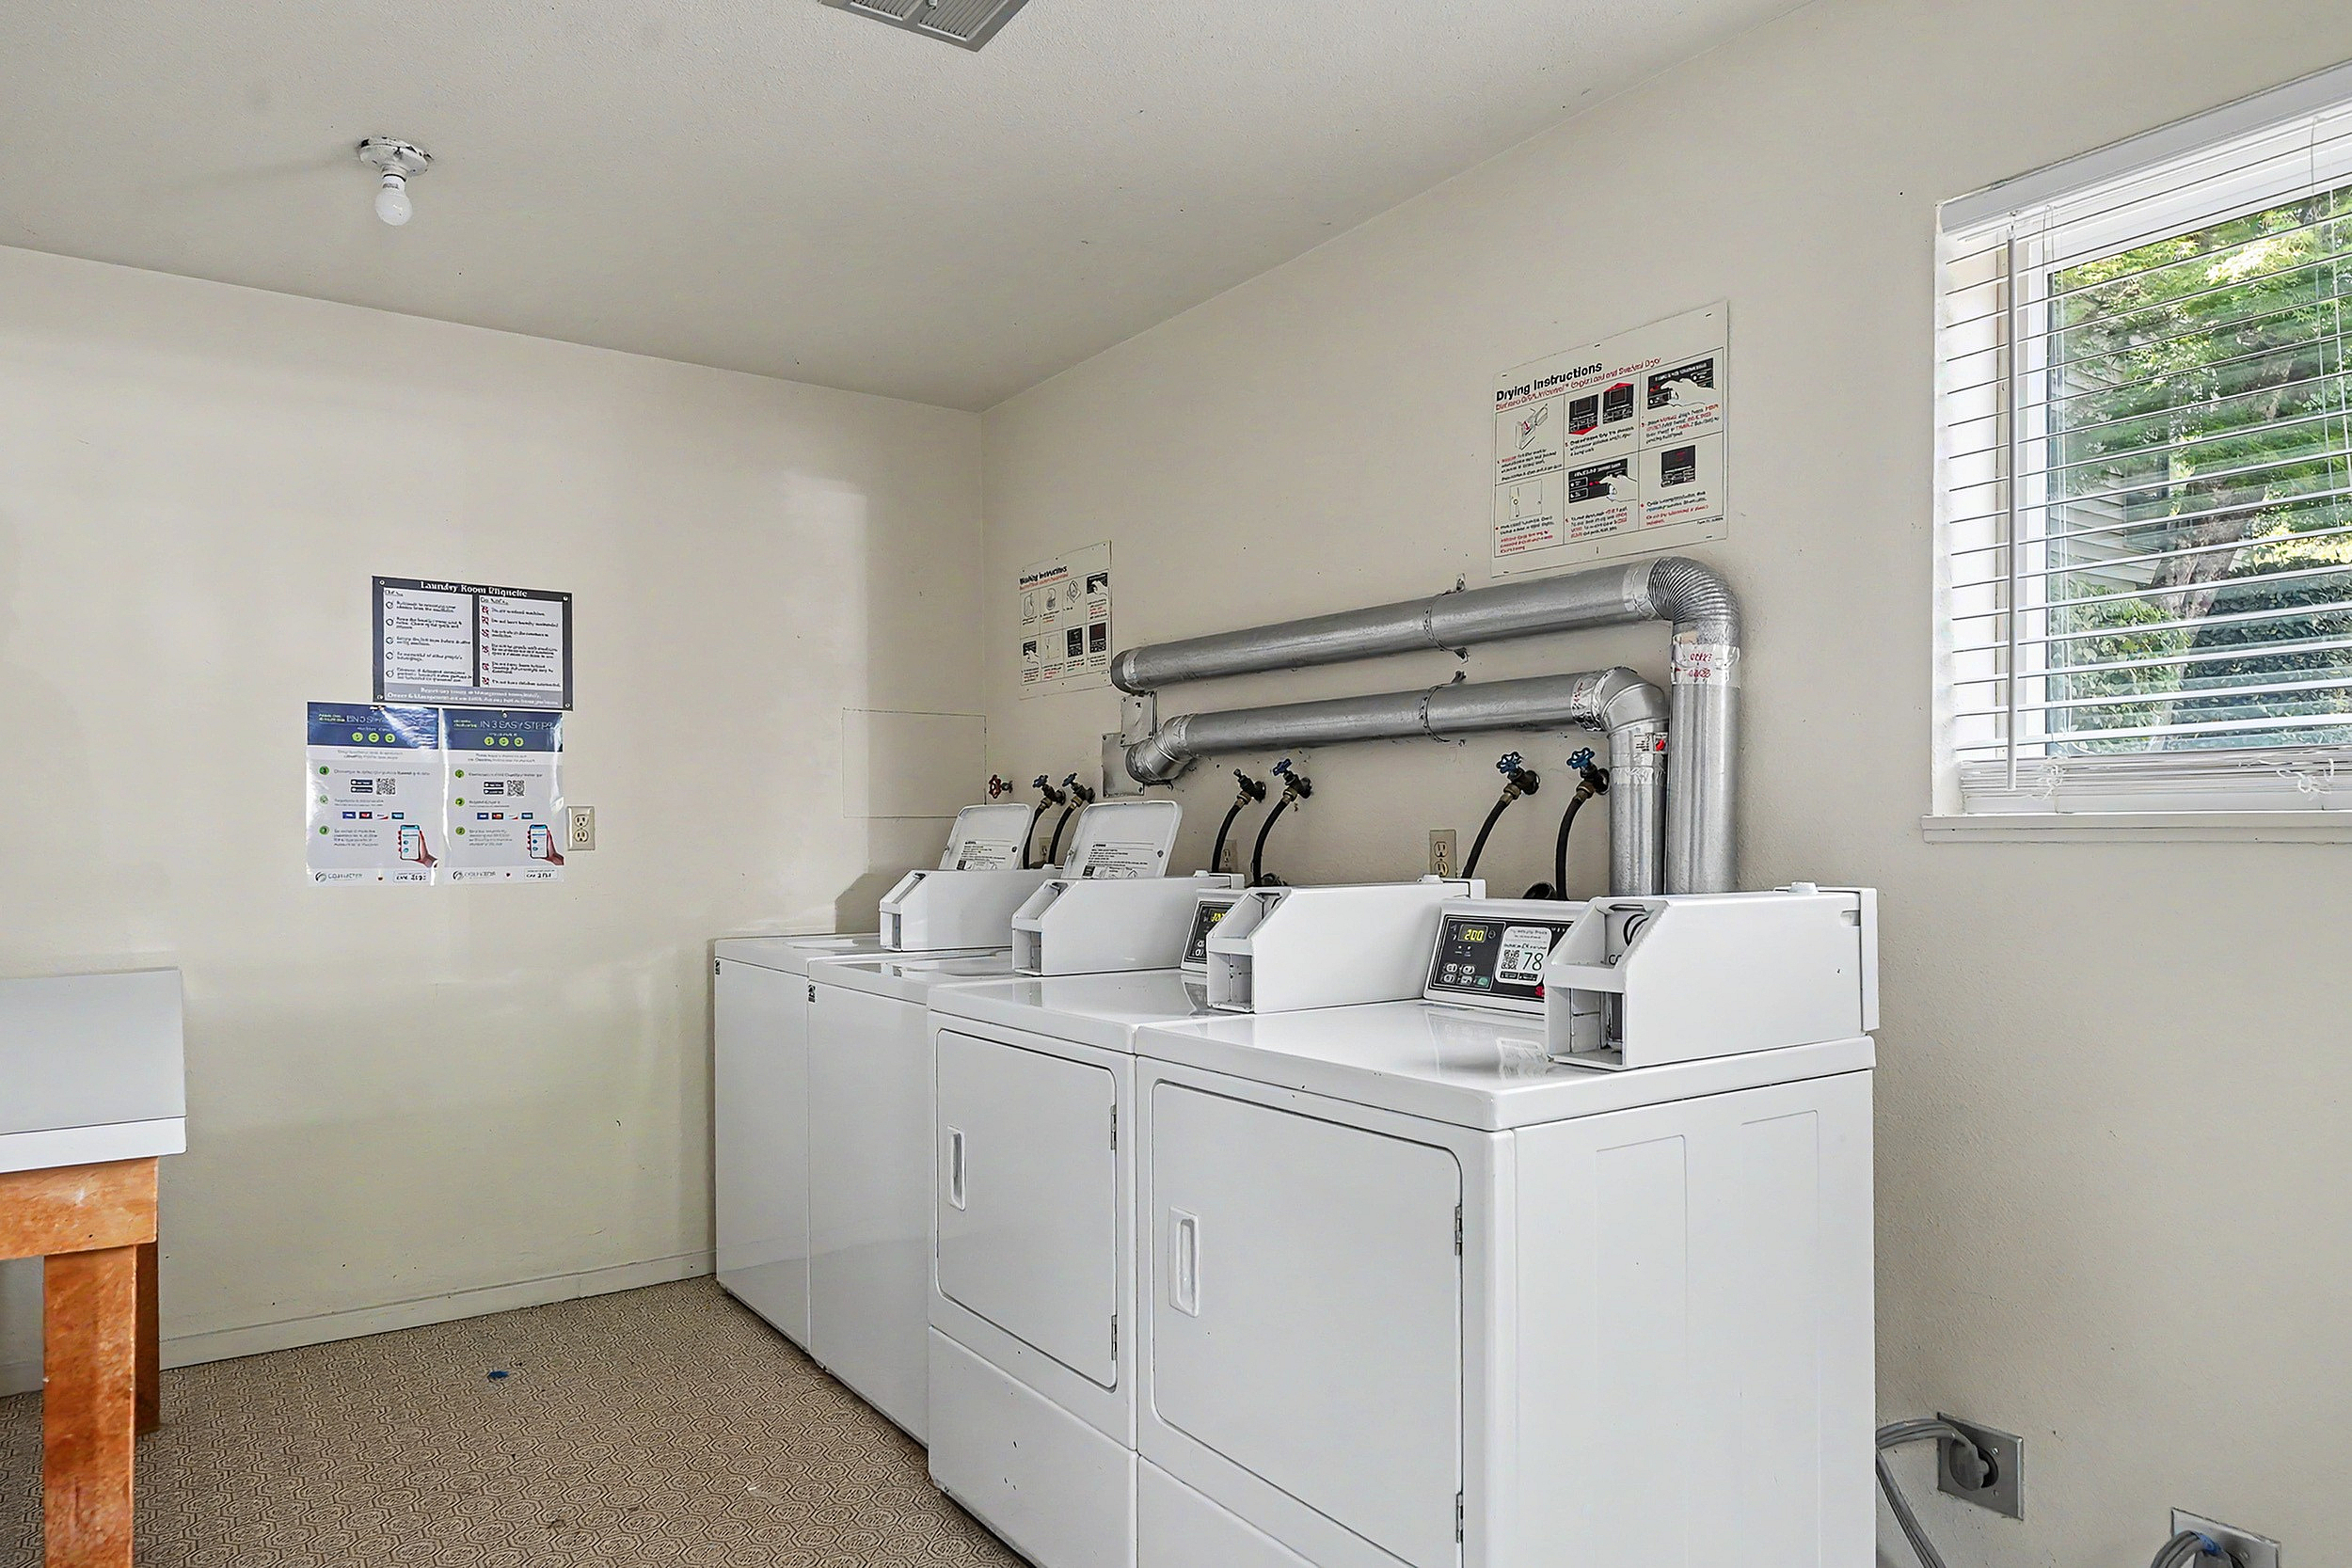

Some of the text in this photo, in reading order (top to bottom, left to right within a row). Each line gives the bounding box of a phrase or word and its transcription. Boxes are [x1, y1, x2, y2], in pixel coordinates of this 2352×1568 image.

[1496, 384, 1531, 402] Drying
[1534, 362, 1602, 391] Instructions
[421, 580, 458, 594] Laundry
[460, 584, 486, 594] Room
[480, 721, 490, 729] IN
[492, 721, 498, 729] 3
[1522, 952, 1544, 972] 78
